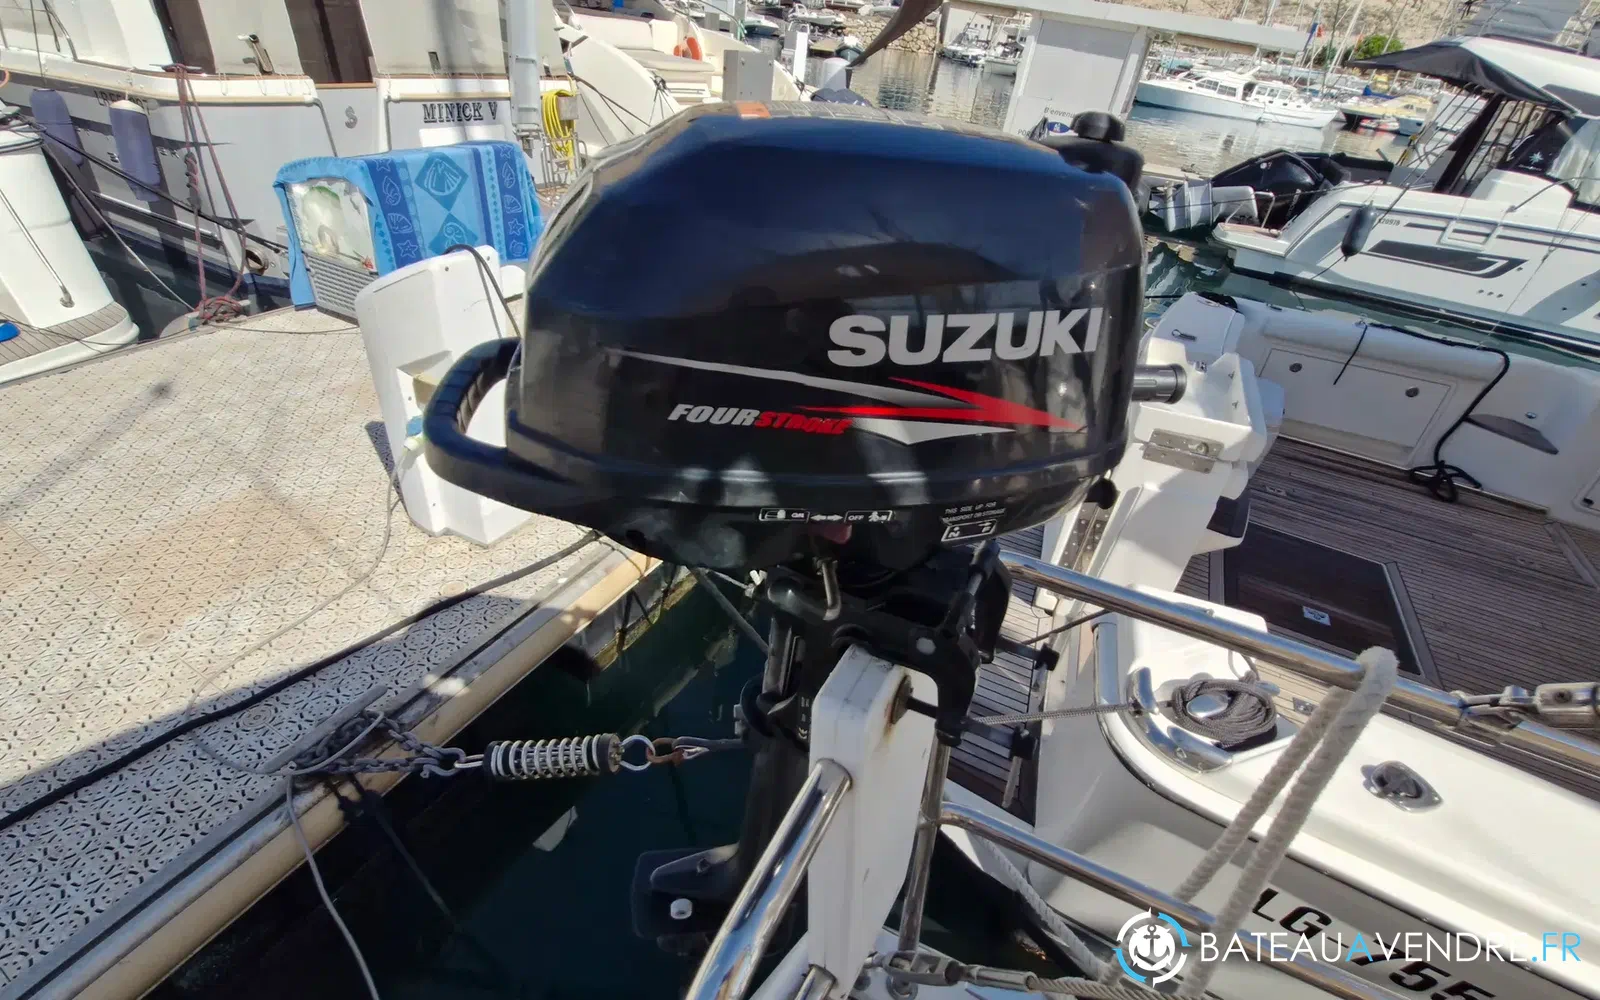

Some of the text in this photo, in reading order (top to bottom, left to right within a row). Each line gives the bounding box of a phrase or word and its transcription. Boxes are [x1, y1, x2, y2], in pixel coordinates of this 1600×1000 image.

[422, 101, 499, 124] MINICK V
[1044, 106, 1077, 120] Bienvenu
[827, 307, 1103, 367] SUZUKI
